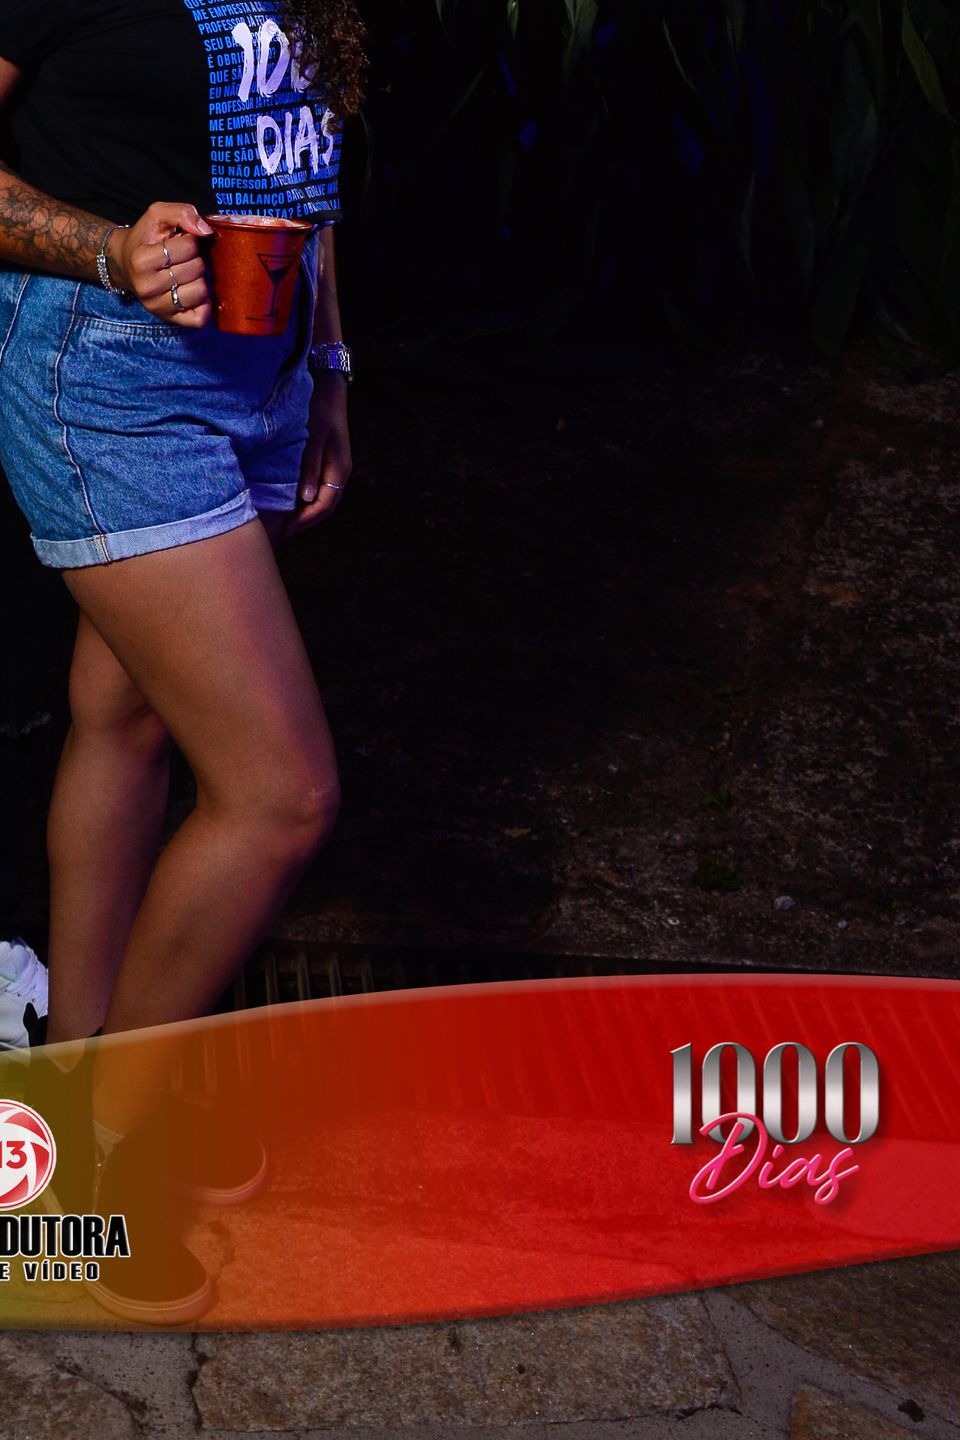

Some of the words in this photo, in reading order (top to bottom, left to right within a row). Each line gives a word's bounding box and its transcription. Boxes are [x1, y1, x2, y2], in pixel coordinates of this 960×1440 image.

[192, 9, 209, 22] ME
[210, 2, 250, 19] EMPRESTA
[198, 16, 245, 35] PROFESSOR
[204, 38, 224, 52] SEU
[208, 55, 214, 69] É
[210, 71, 229, 85] QUE
[209, 86, 222, 100] EU
[209, 98, 254, 115] PROFESSOR
[209, 118, 225, 132] ME
[210, 135, 234, 148] TEM
[237, 133, 251, 146] NA
[256, 105, 336, 175] DIAS
[211, 151, 231, 162] QUE
[233, 148, 253, 162] SÃO
[212, 165, 225, 176] EU
[228, 164, 250, 178] NÃO
[212, 177, 268, 190] PROFESSOR
[216, 192, 233, 205] SEU
[236, 191, 285, 207] BALANÇO
[256, 208, 293, 220] LISTA?
[297, 203, 302, 218] É
